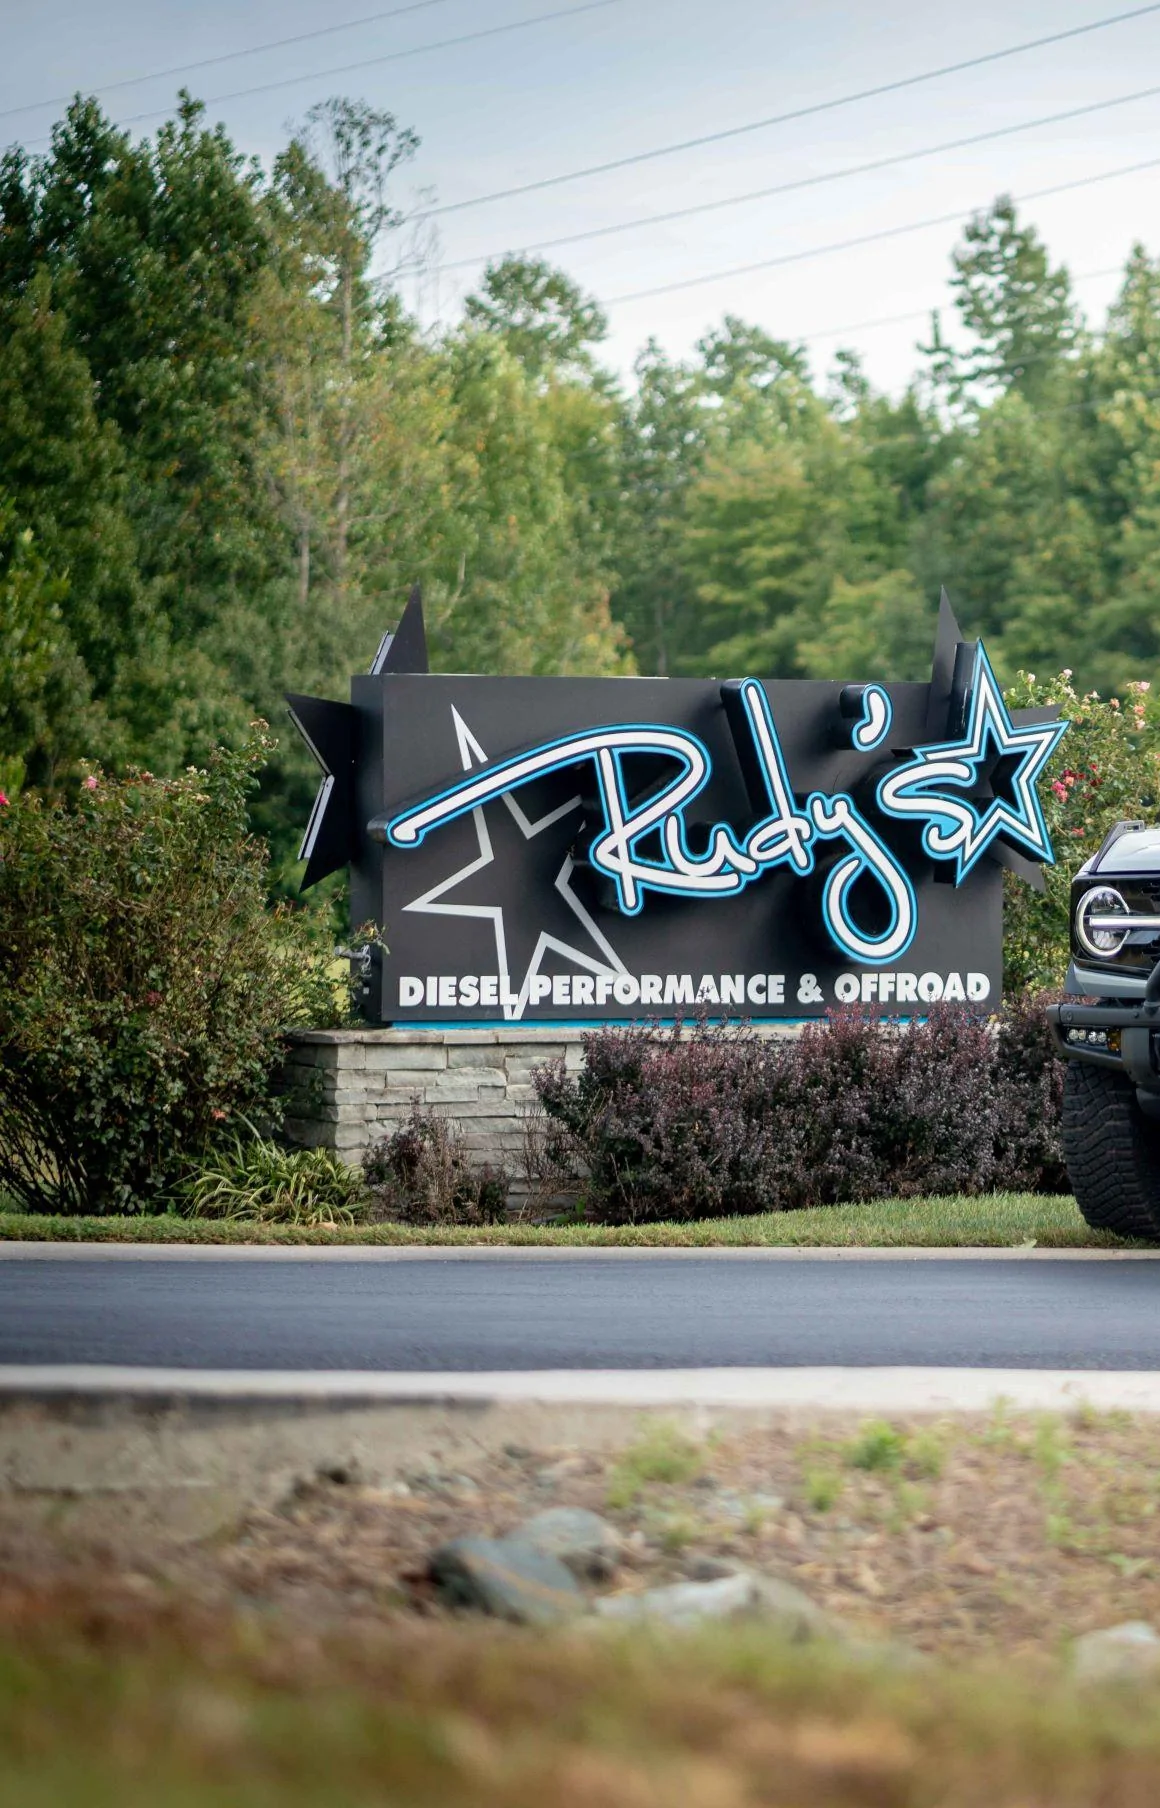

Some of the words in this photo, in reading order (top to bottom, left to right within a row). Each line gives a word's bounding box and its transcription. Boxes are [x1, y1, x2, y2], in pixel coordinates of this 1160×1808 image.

[399, 976, 519, 1006] DIESEL
[529, 974, 785, 1005] PERFORMANCE
[797, 973, 825, 1004] &
[834, 972, 991, 1003] OFFROAD
